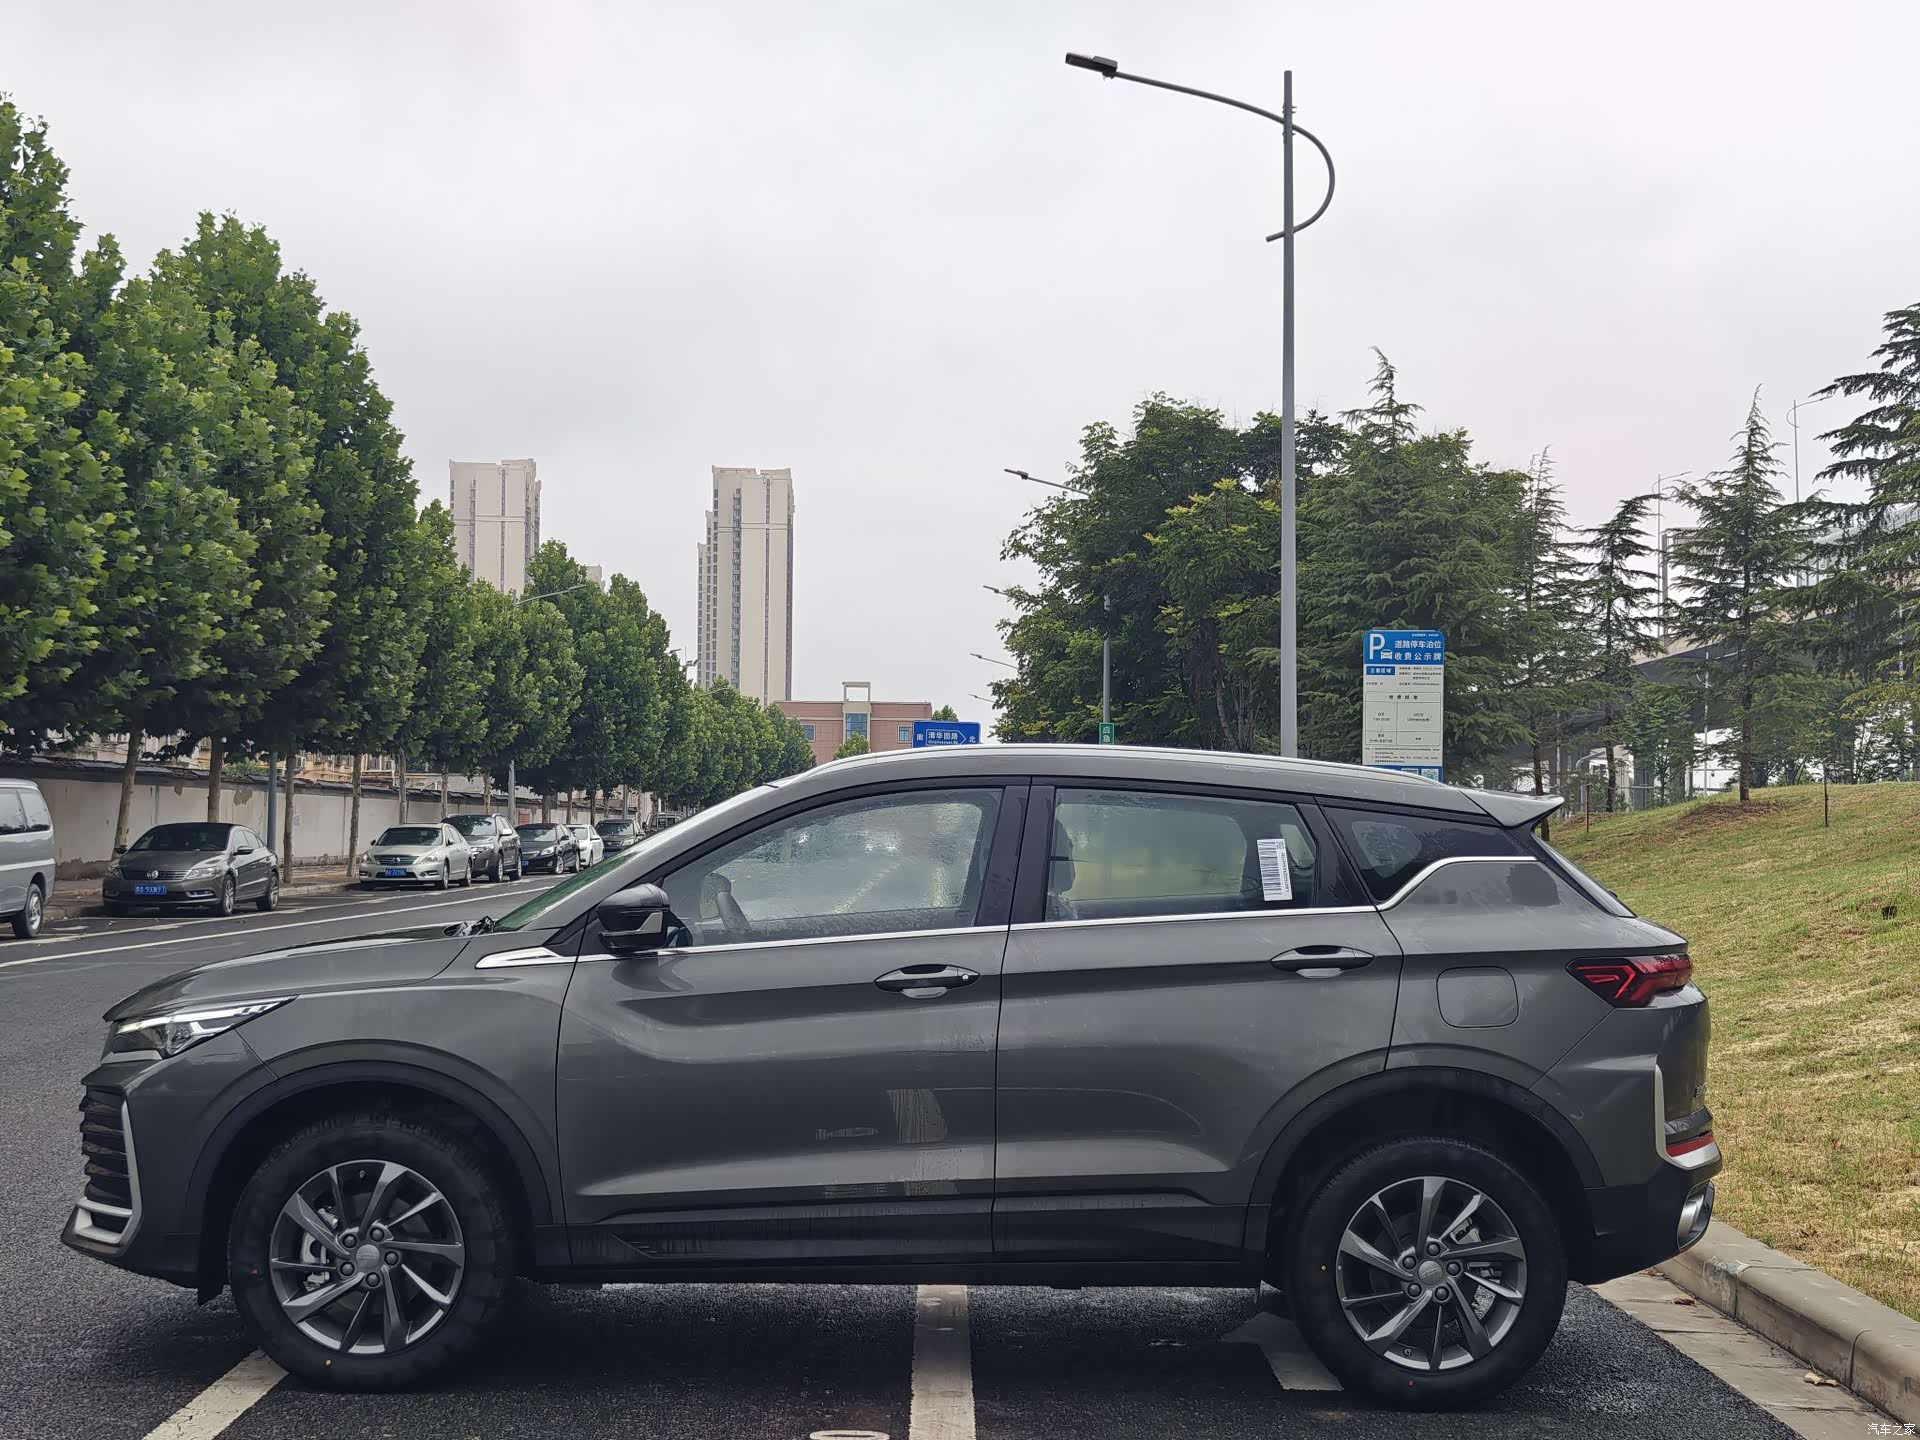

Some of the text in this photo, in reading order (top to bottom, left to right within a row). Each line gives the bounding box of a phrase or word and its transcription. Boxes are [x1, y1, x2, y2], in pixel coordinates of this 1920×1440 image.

[1369, 633, 1386, 660] P
[1394, 640, 1442, 649] 道路停车泊位
[1394, 652, 1442, 661] 收费公示牌
[928, 731, 959, 741] 清华园路
[968, 735, 976, 743] 北
